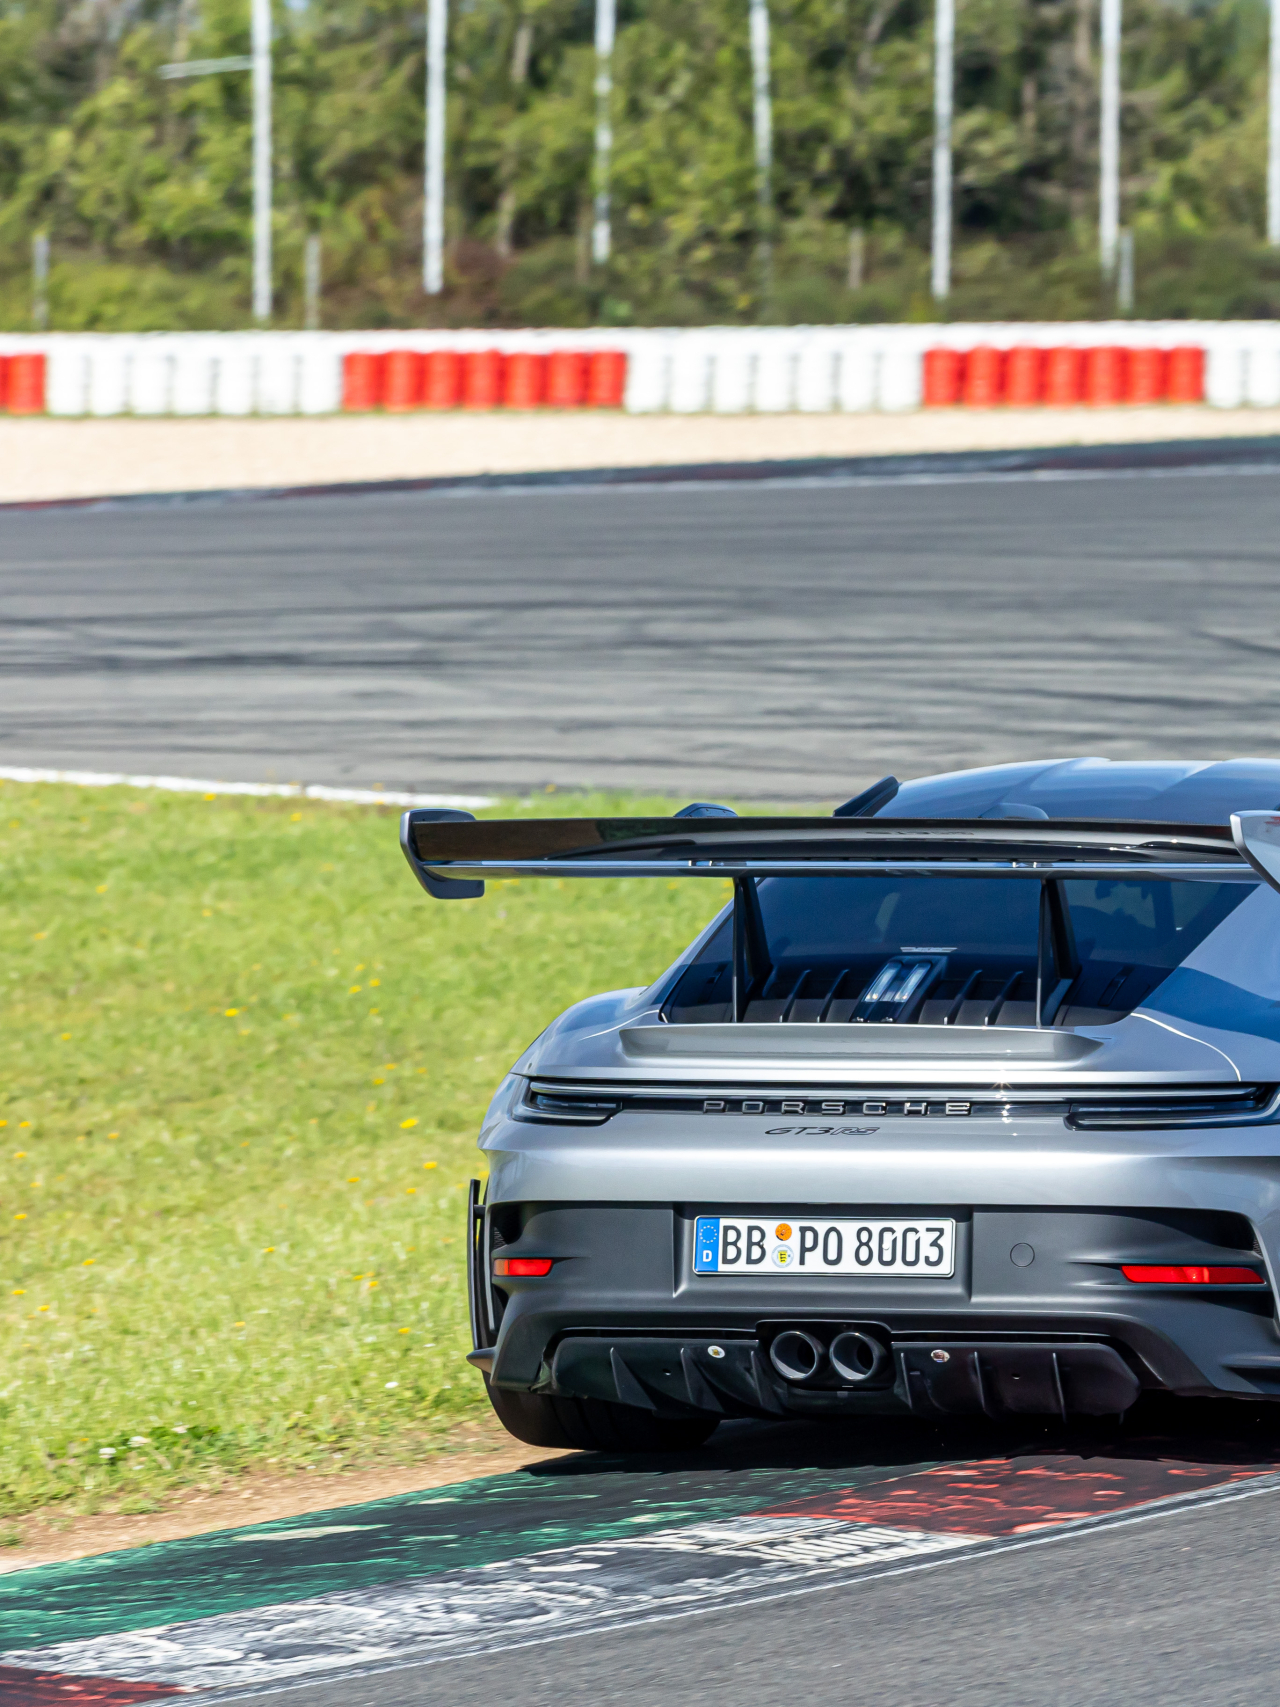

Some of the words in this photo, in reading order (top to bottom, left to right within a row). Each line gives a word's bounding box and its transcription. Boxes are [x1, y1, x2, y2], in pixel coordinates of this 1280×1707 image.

[702, 1100, 972, 1115] PORSCHE
[721, 1225, 767, 1265] BB
[798, 1226, 844, 1266] PO
[854, 1226, 945, 1267] 8003
[702, 1250, 713, 1262] D
